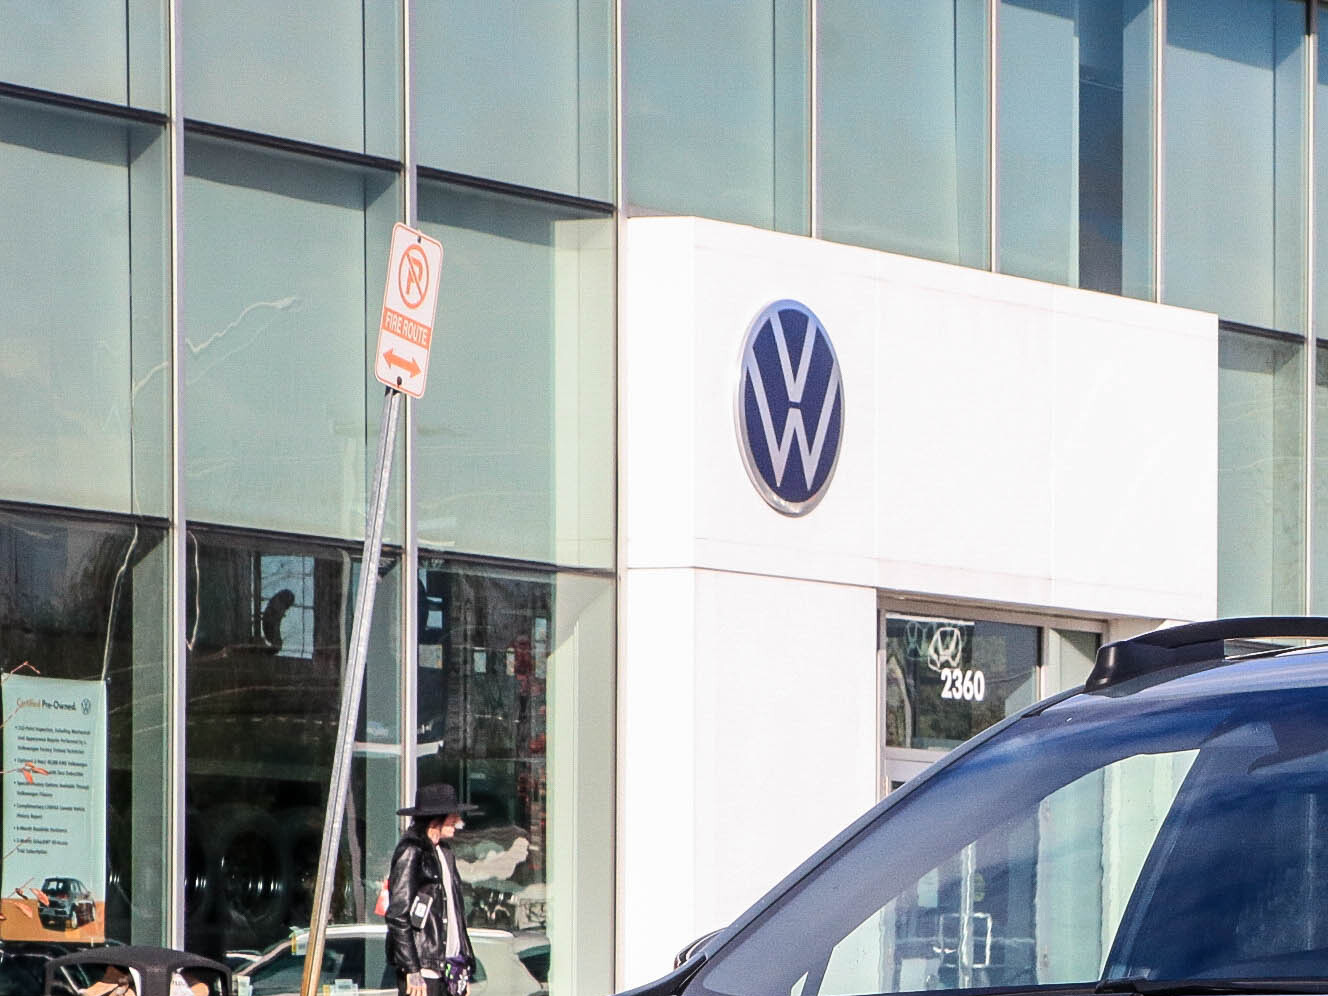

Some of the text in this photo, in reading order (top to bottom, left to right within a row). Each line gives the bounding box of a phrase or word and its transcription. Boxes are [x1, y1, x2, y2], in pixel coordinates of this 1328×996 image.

[385, 312, 428, 345] FIRE ROUTE
[743, 304, 843, 498] VW
[940, 667, 985, 701] 2360
